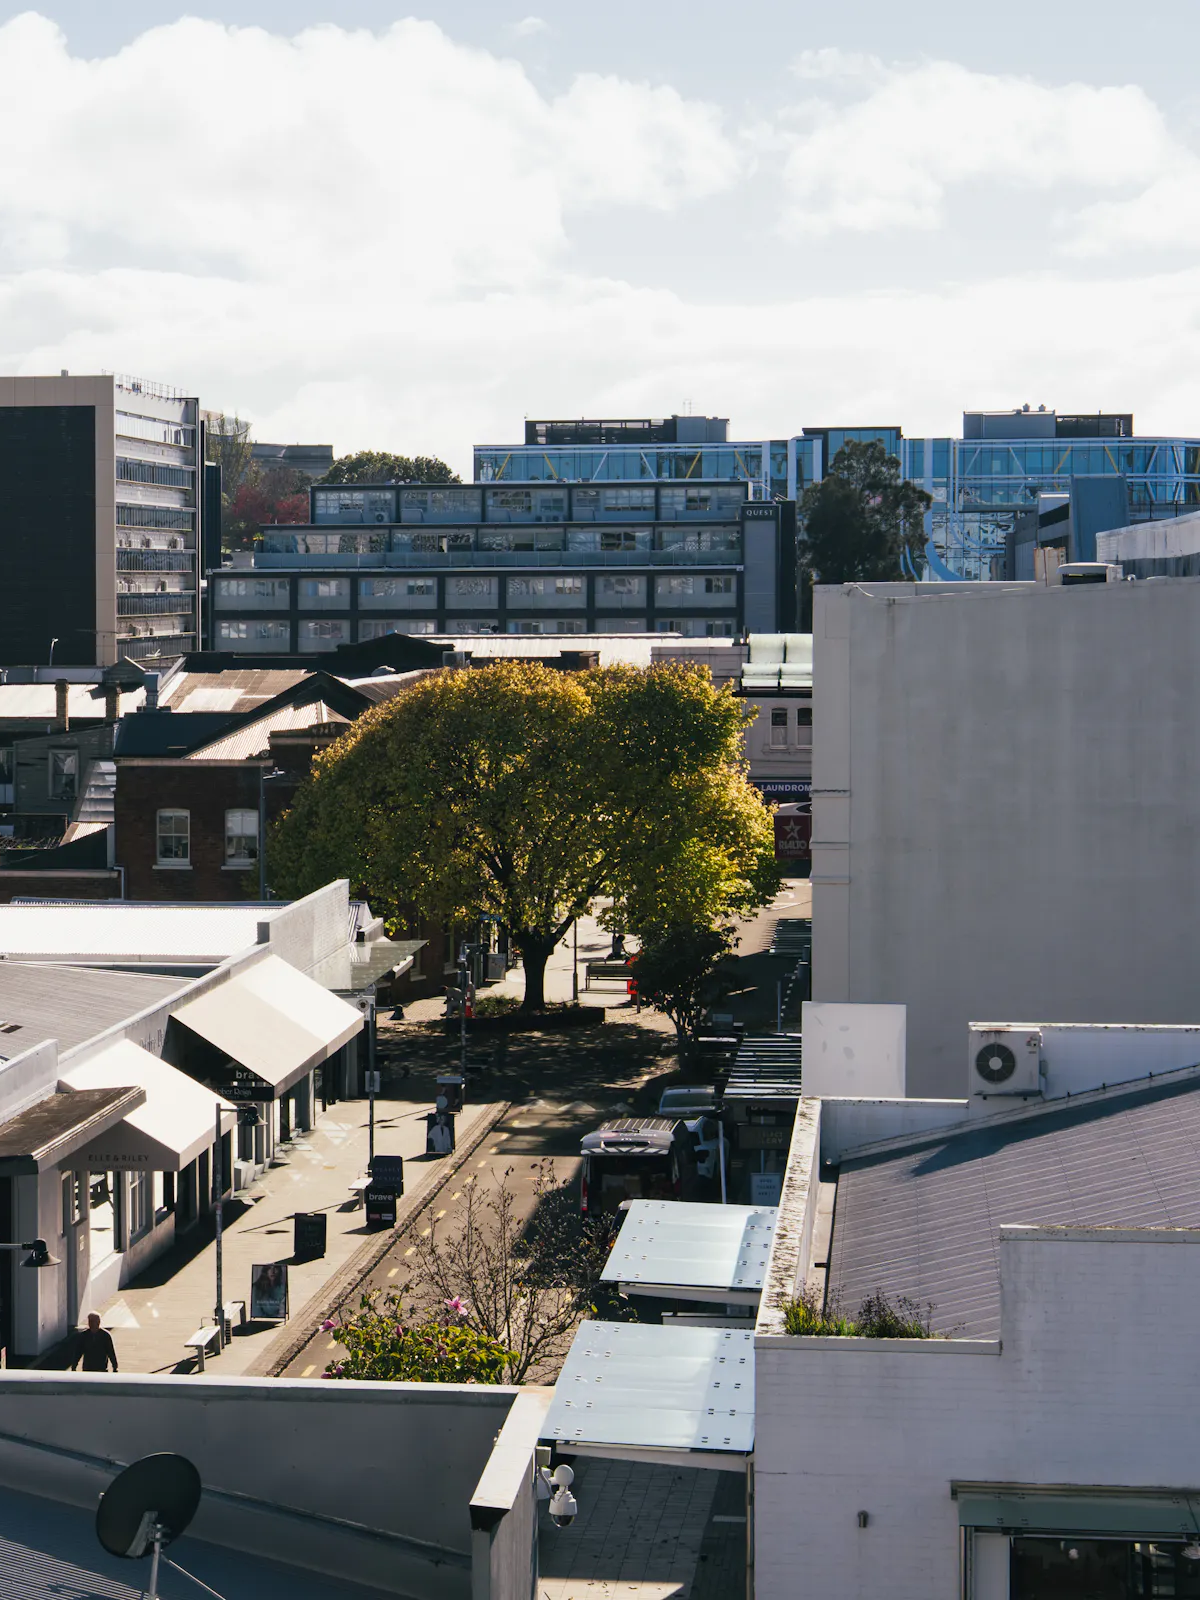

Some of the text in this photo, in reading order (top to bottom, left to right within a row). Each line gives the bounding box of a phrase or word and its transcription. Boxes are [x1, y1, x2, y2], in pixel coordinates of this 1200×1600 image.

[778, 840, 807, 850] RIALTO
[235, 1070, 260, 1079] bra
[88, 1154, 111, 1162] ELLE
[121, 1154, 149, 1162] RILEY
[368, 1192, 394, 1201] brave
